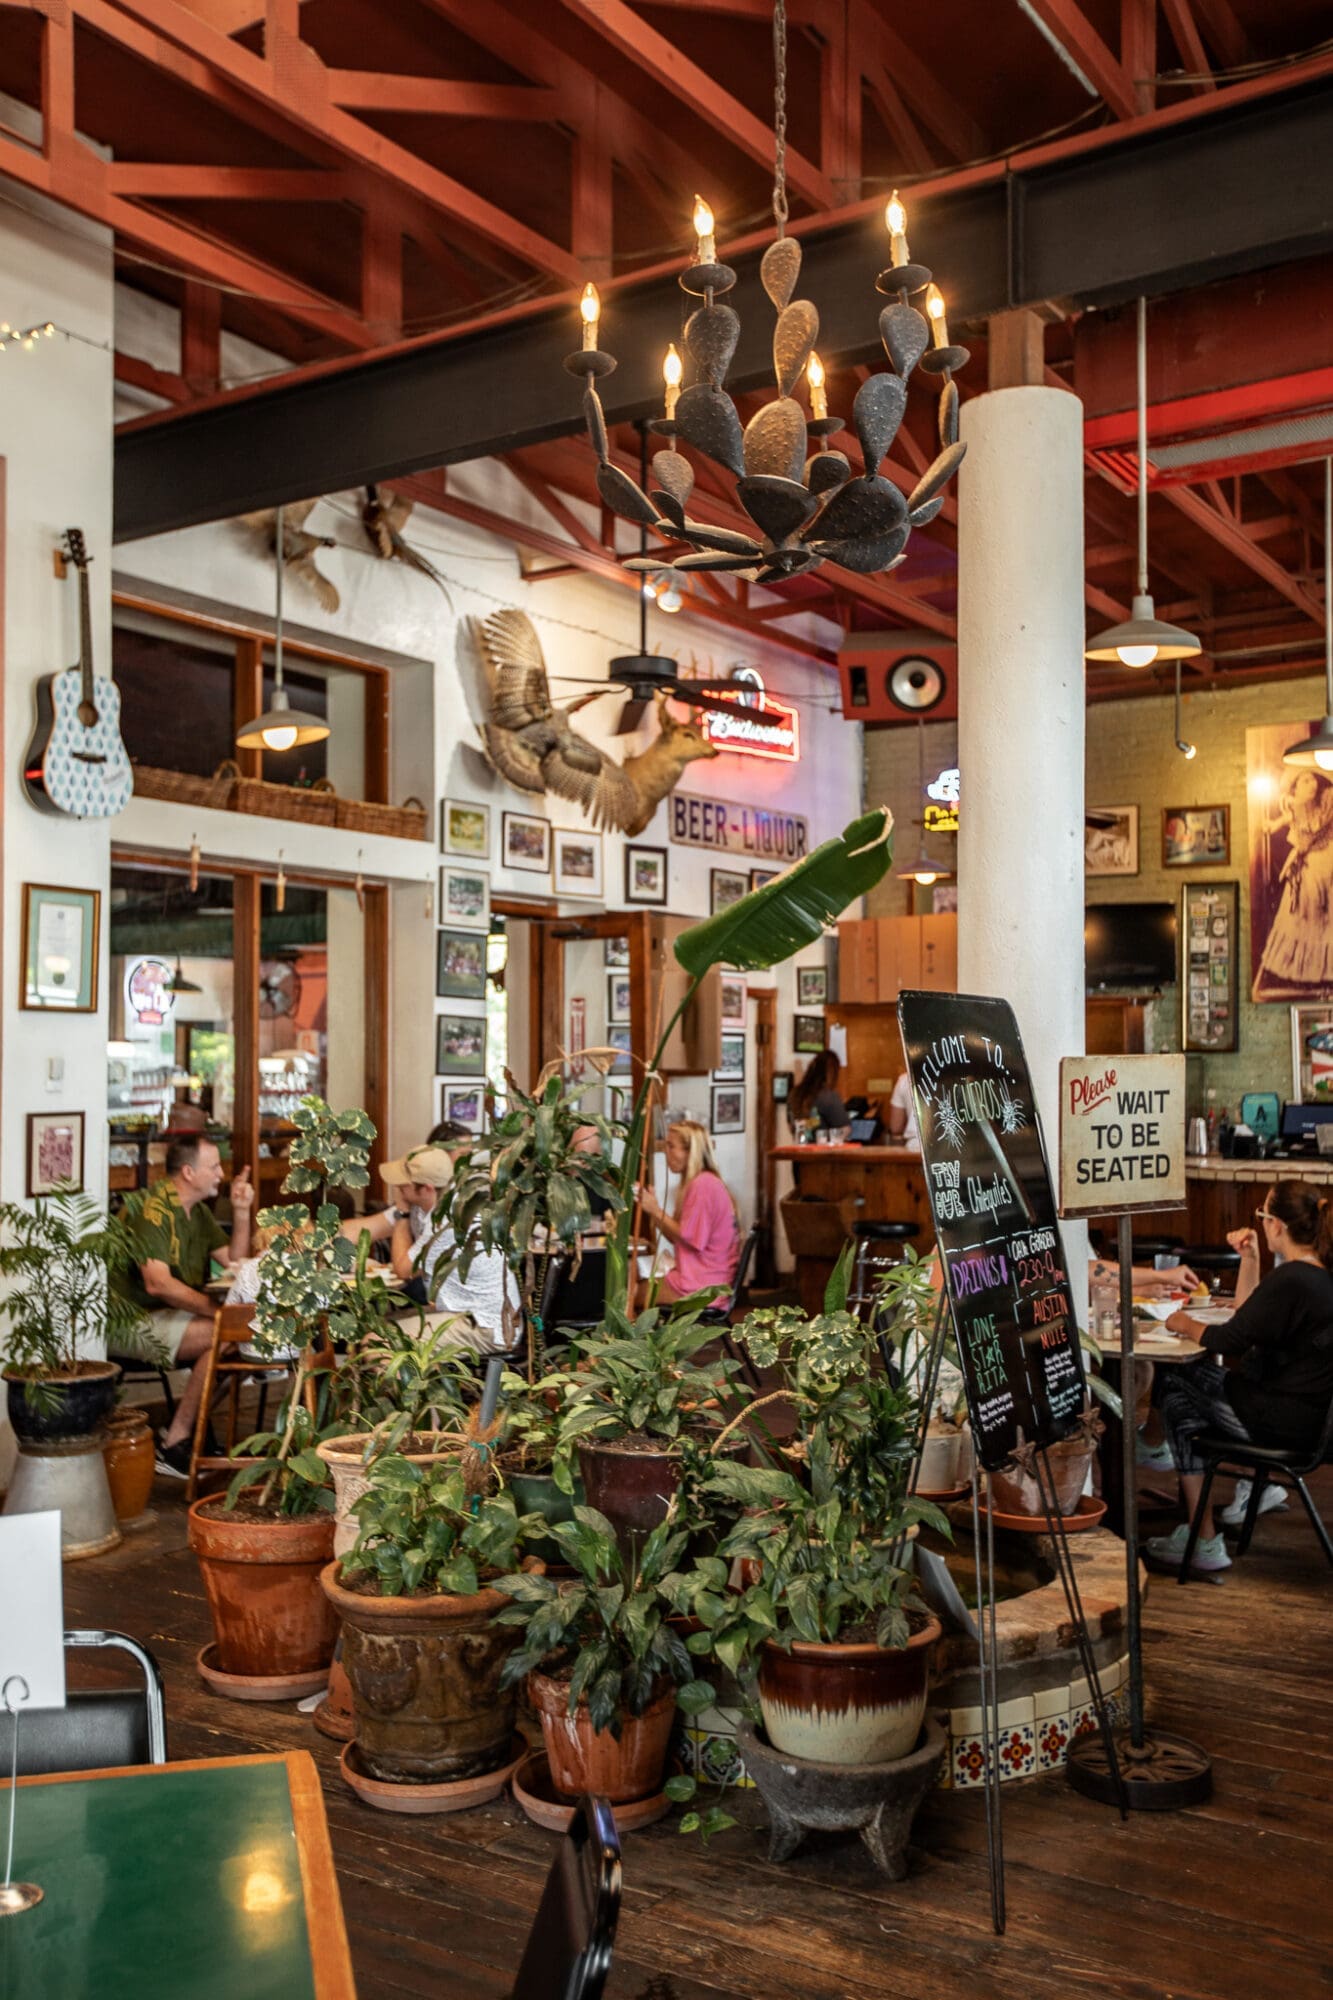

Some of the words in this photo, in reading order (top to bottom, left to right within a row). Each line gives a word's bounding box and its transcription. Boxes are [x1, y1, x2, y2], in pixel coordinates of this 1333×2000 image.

[917, 1034, 971, 1107] WELCOME
[1070, 1069, 1118, 1115] Please
[1117, 1090, 1170, 1115] WAIT
[1091, 1124, 1123, 1149] TO
[1131, 1122, 1160, 1147] BE
[931, 1160, 960, 1188] TRY
[1076, 1154, 1171, 1184] SEATED
[951, 1256, 1001, 1299] DRINKS
[1033, 1294, 1069, 1325] AUSTIN
[964, 1313, 1000, 1348] LONE
[976, 1366, 1009, 1395] RITA
